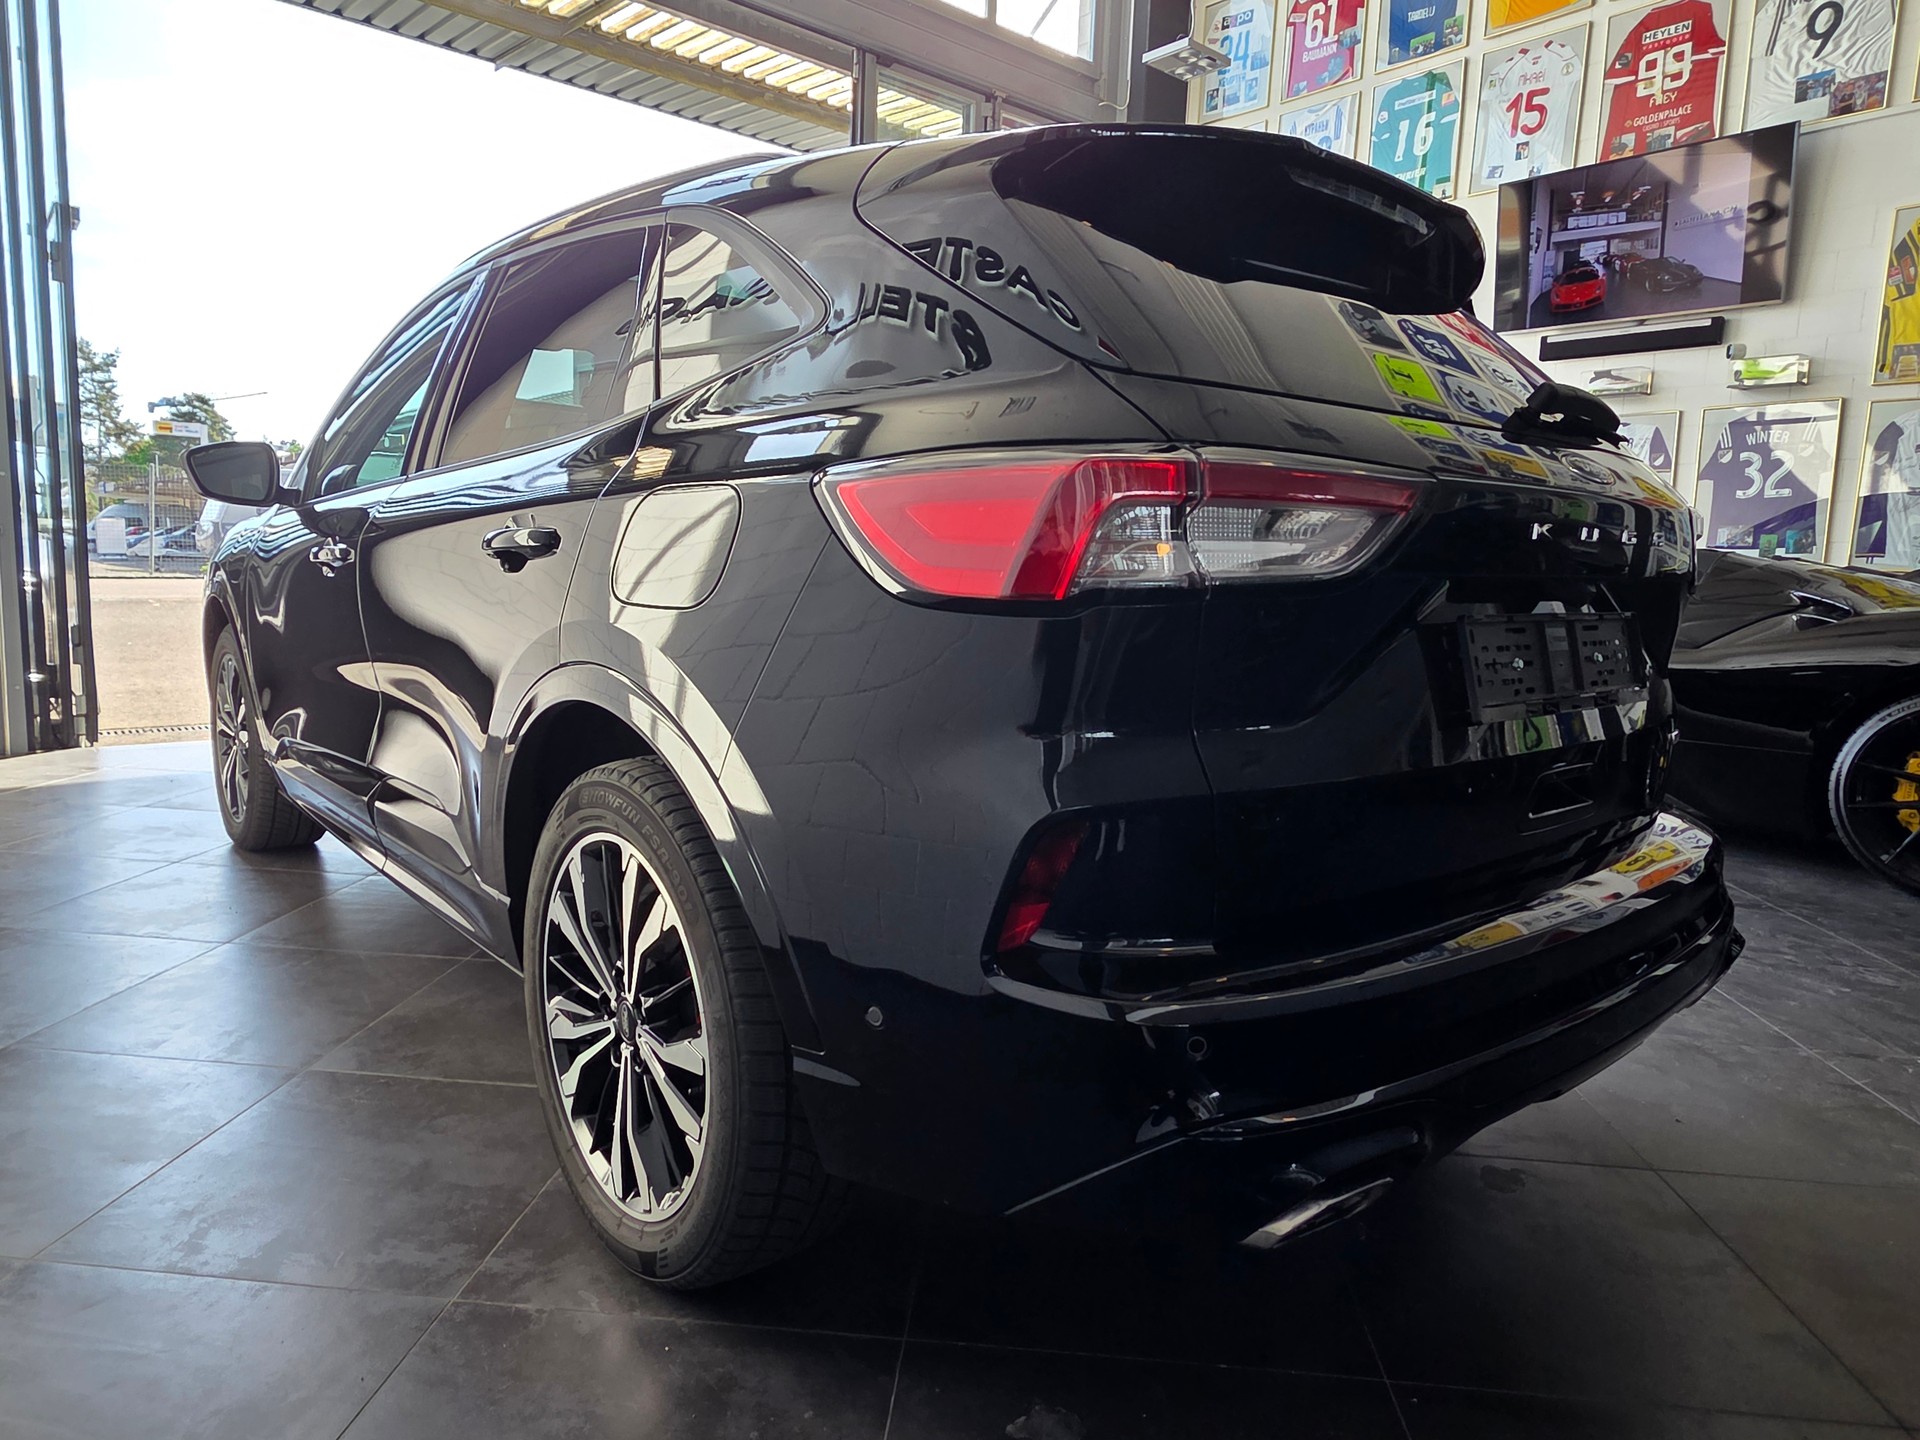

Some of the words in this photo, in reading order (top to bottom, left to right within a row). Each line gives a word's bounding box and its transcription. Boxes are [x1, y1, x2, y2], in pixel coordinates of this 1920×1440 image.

[1304, 0, 1339, 49] 61
[1643, 21, 1691, 43] HEYLEN
[1806, 1, 1844, 60] 9
[1636, 41, 1693, 98] 99
[1394, 111, 1437, 163] 16
[1505, 86, 1551, 139] 15
[1633, 103, 1693, 127] GOLDENPALACE
[1745, 429, 1791, 447] WINTER
[1735, 449, 1796, 499] 32
